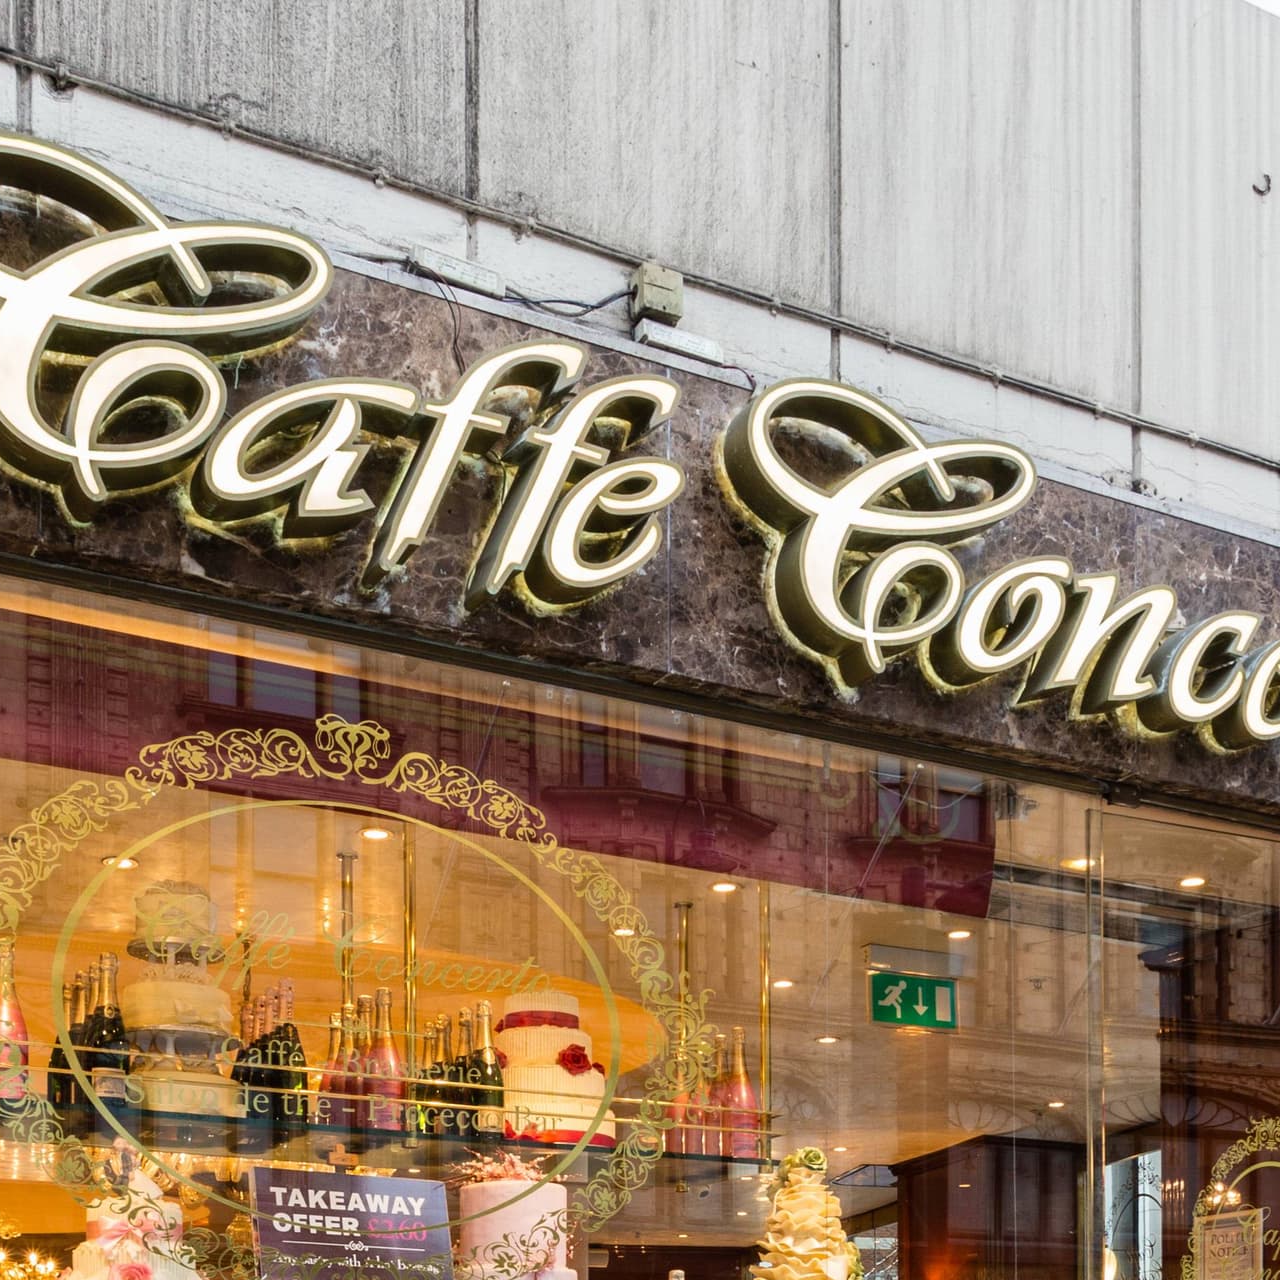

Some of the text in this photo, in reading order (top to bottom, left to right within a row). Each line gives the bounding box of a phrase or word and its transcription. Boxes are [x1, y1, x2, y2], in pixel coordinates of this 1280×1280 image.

[323, 909, 555, 994] Concerto
[221, 1036, 305, 1068] Caffé
[341, 1047, 482, 1085] Brasserie
[233, 1082, 269, 1113] de
[515, 1105, 563, 1132] Bar
[270, 1186, 426, 1217] TAKEAWAY
[272, 1212, 428, 1242] OFFER £2.60
